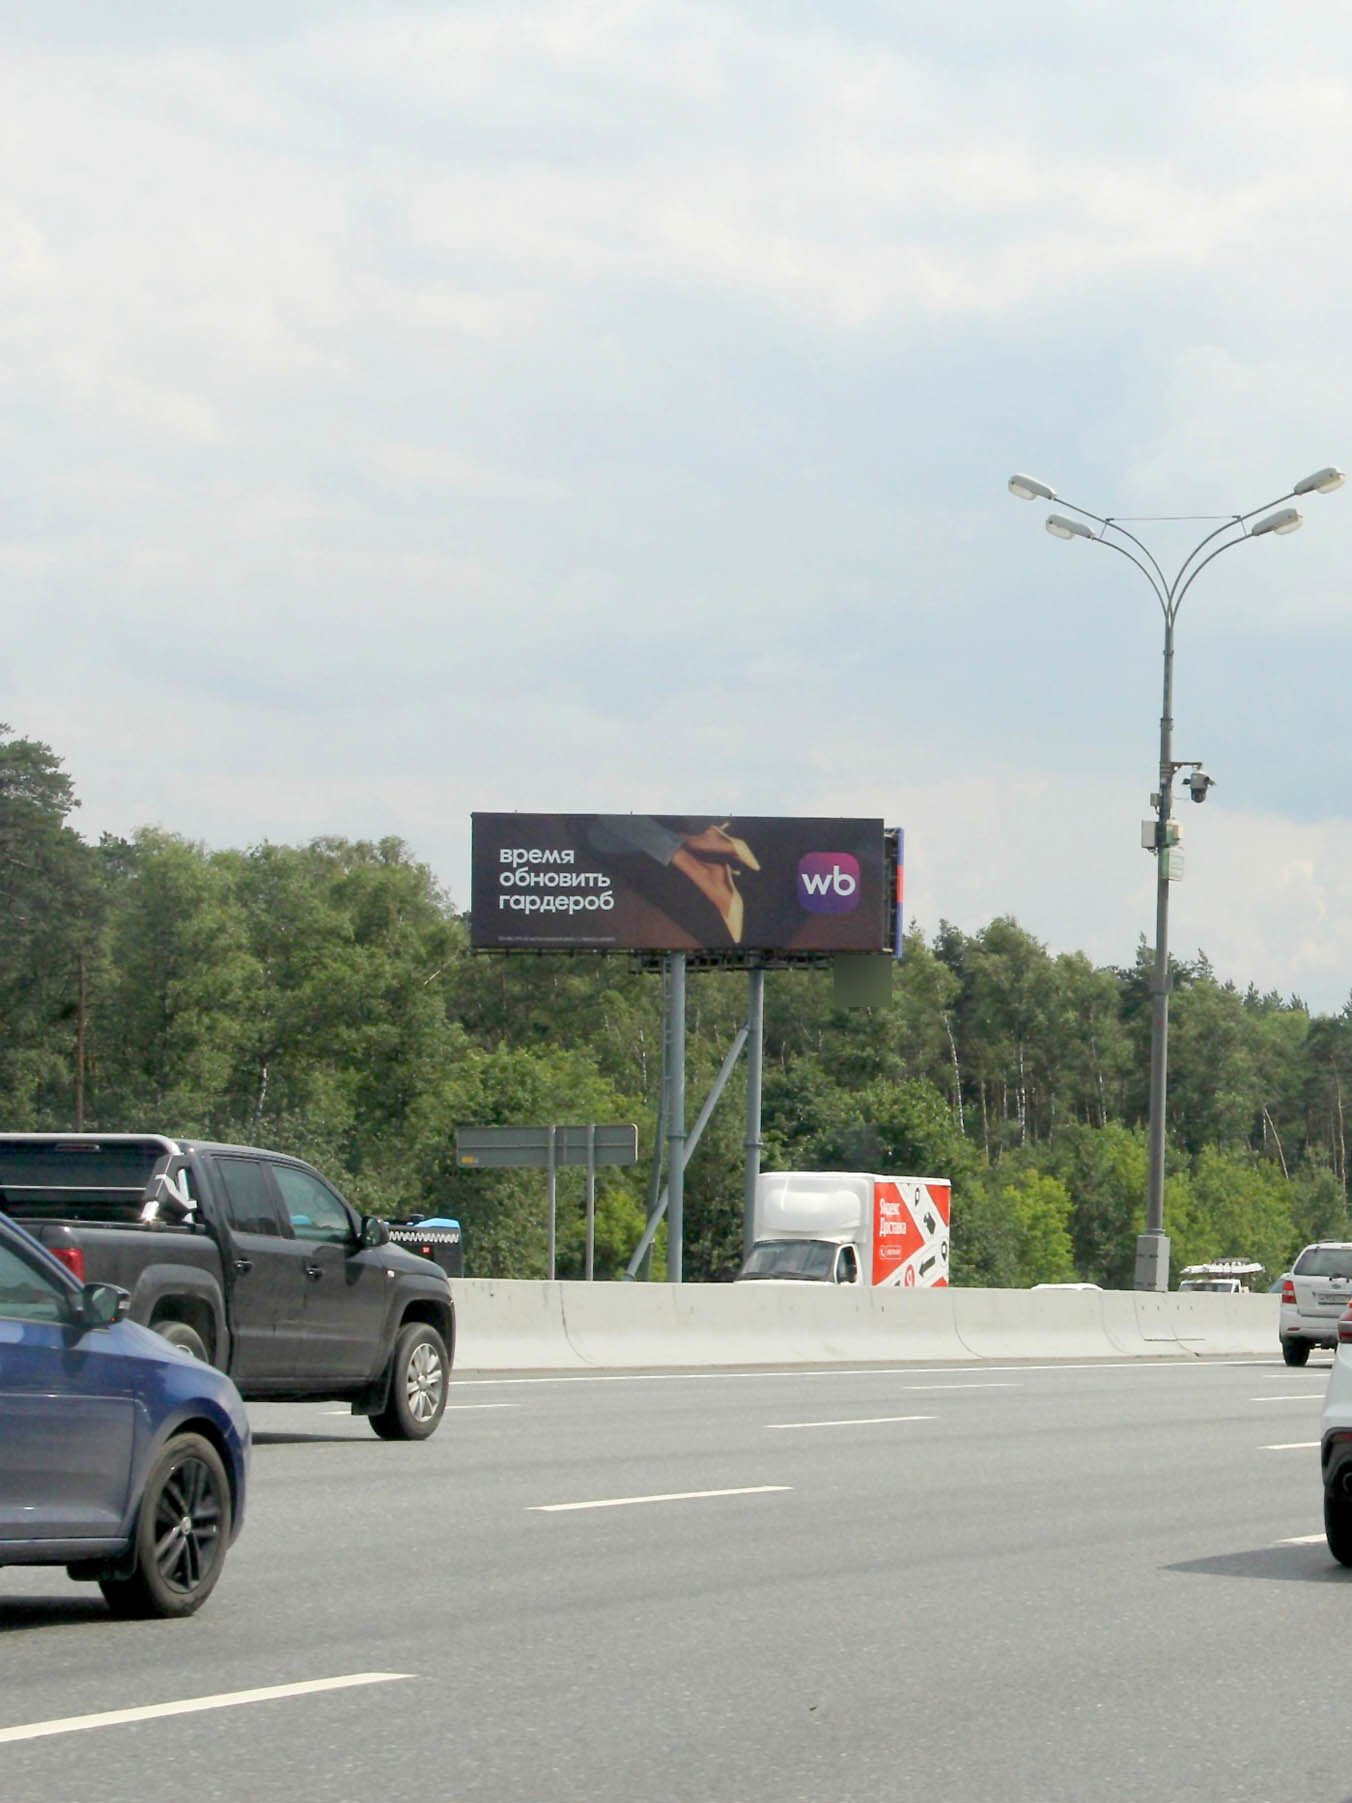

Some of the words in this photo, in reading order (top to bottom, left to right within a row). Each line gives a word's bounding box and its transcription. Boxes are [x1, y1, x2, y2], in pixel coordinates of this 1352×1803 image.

[499, 848, 575, 868] время
[499, 866, 611, 887] обновить
[801, 865, 856, 896] wb
[499, 890, 615, 915] гардероб
